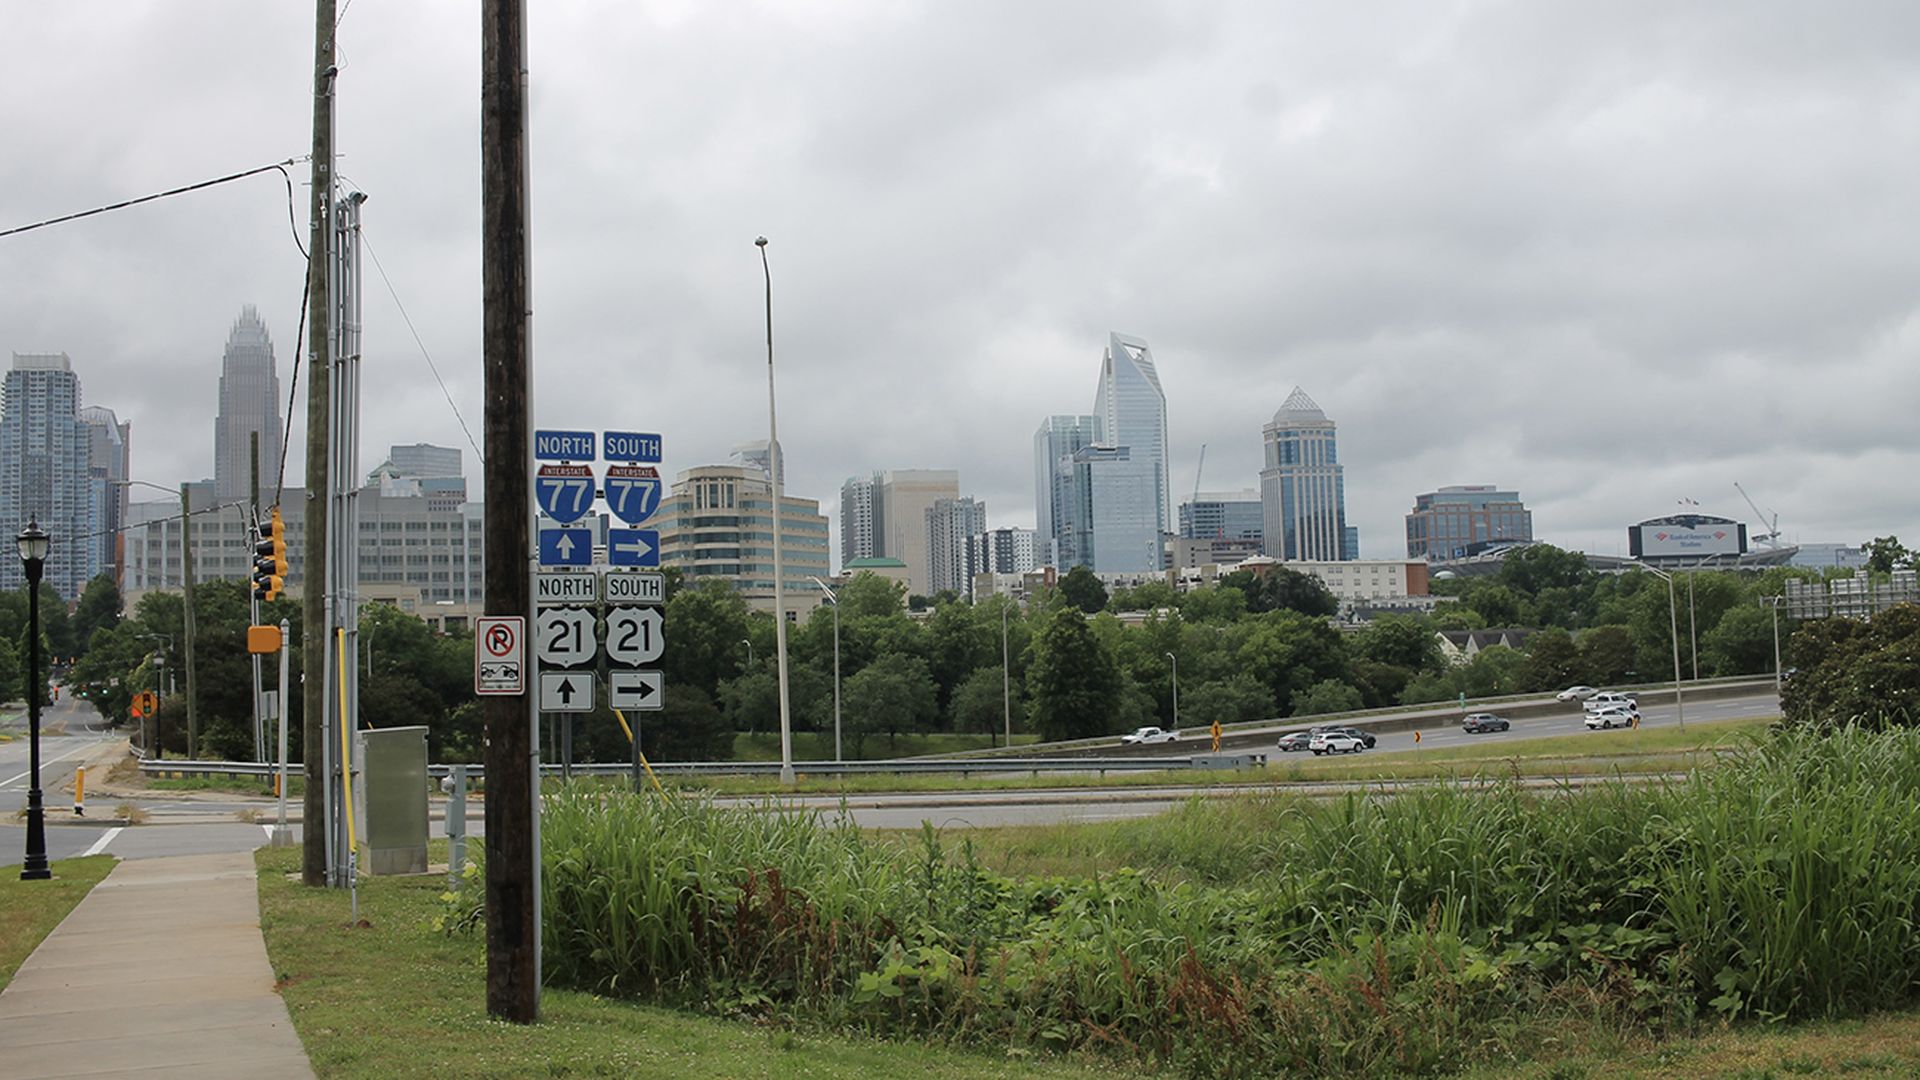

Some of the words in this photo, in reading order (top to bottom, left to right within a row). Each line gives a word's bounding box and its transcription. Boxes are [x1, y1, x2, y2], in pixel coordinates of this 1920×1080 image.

[538, 436, 593, 456] NORTH
[607, 437, 660, 457] SOUTH
[544, 467, 588, 476] INTERSTATE
[612, 467, 653, 477] INTERSTATE
[542, 480, 588, 512] 77
[610, 481, 655, 513] 77
[539, 577, 593, 596] NORTH
[610, 578, 660, 597] SOUTH
[547, 619, 582, 653] 21
[616, 619, 650, 652] 21
